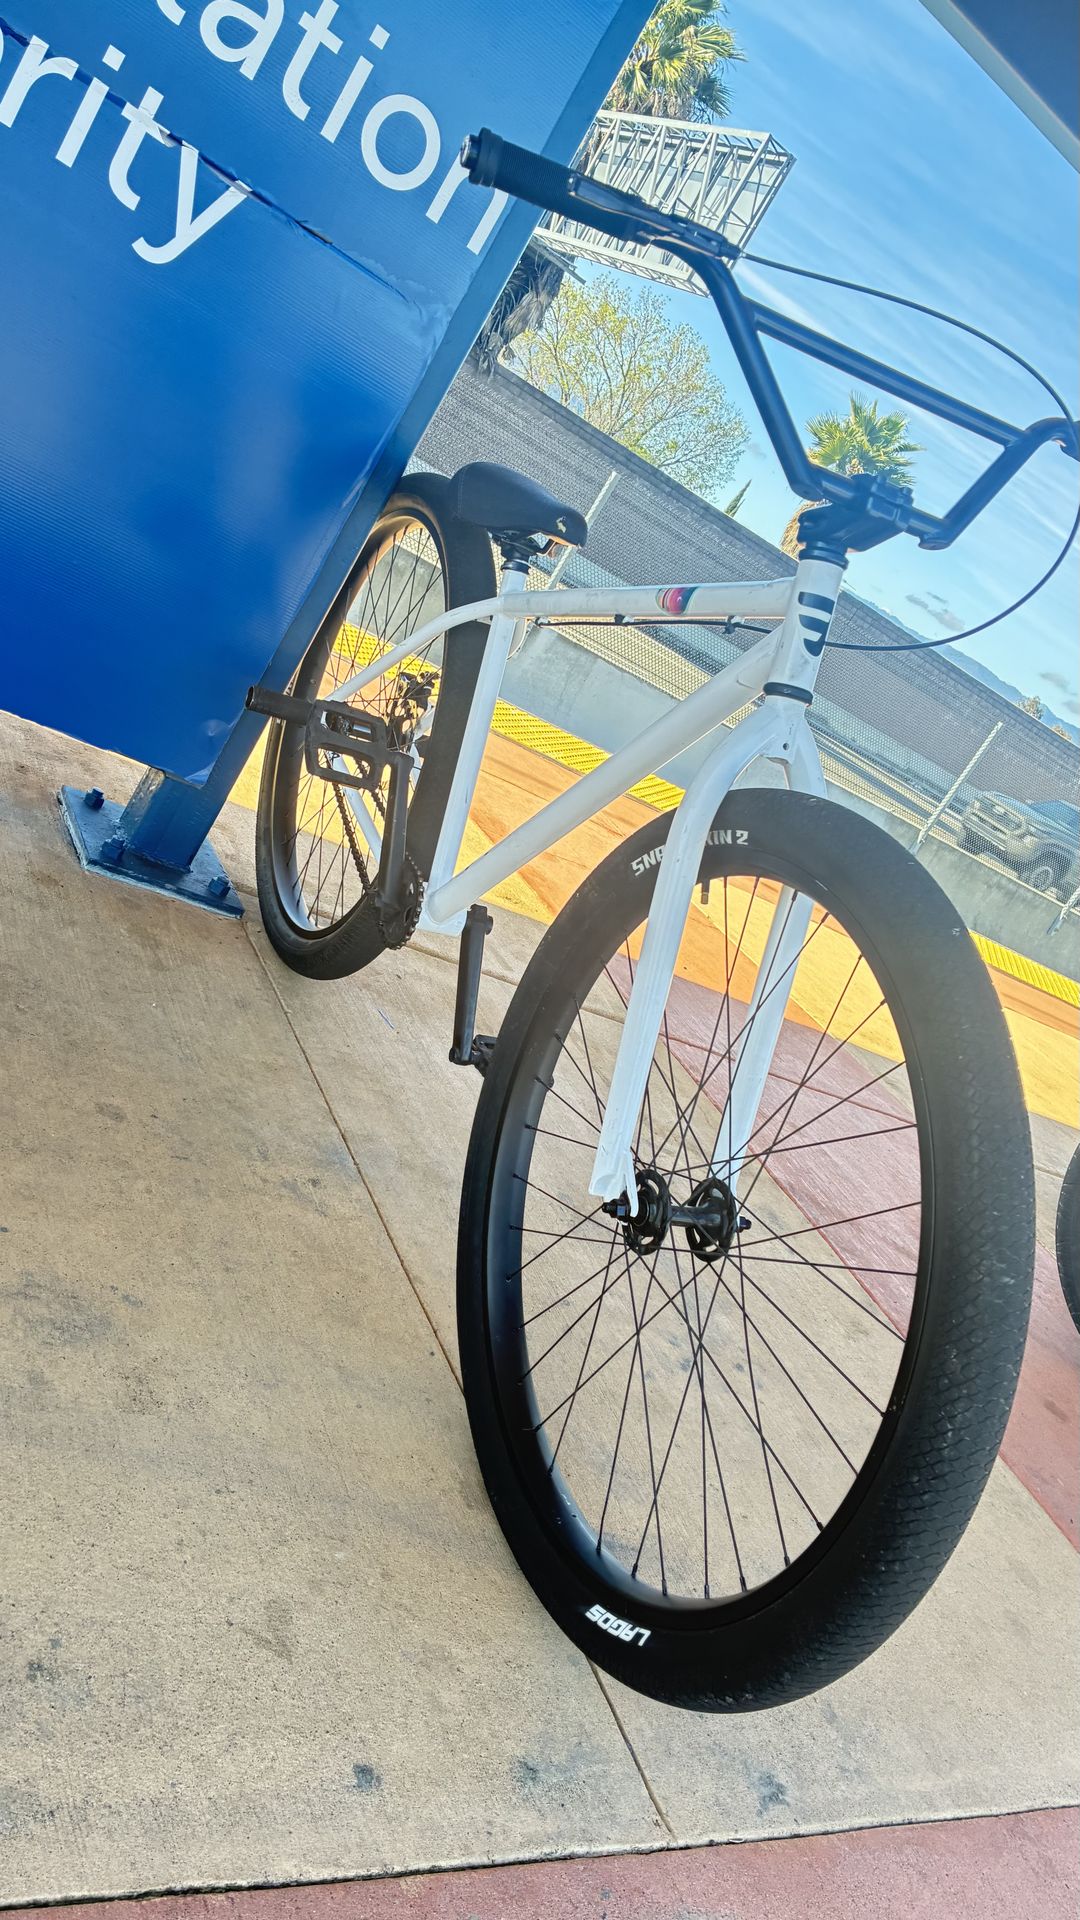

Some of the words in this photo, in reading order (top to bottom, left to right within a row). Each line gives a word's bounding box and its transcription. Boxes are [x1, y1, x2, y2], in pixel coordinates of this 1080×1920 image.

[0, 27, 253, 265] rity
[155, 0, 510, 256] ation
[735, 829, 749, 846] 2
[585, 1604, 651, 1646] LAGOS
